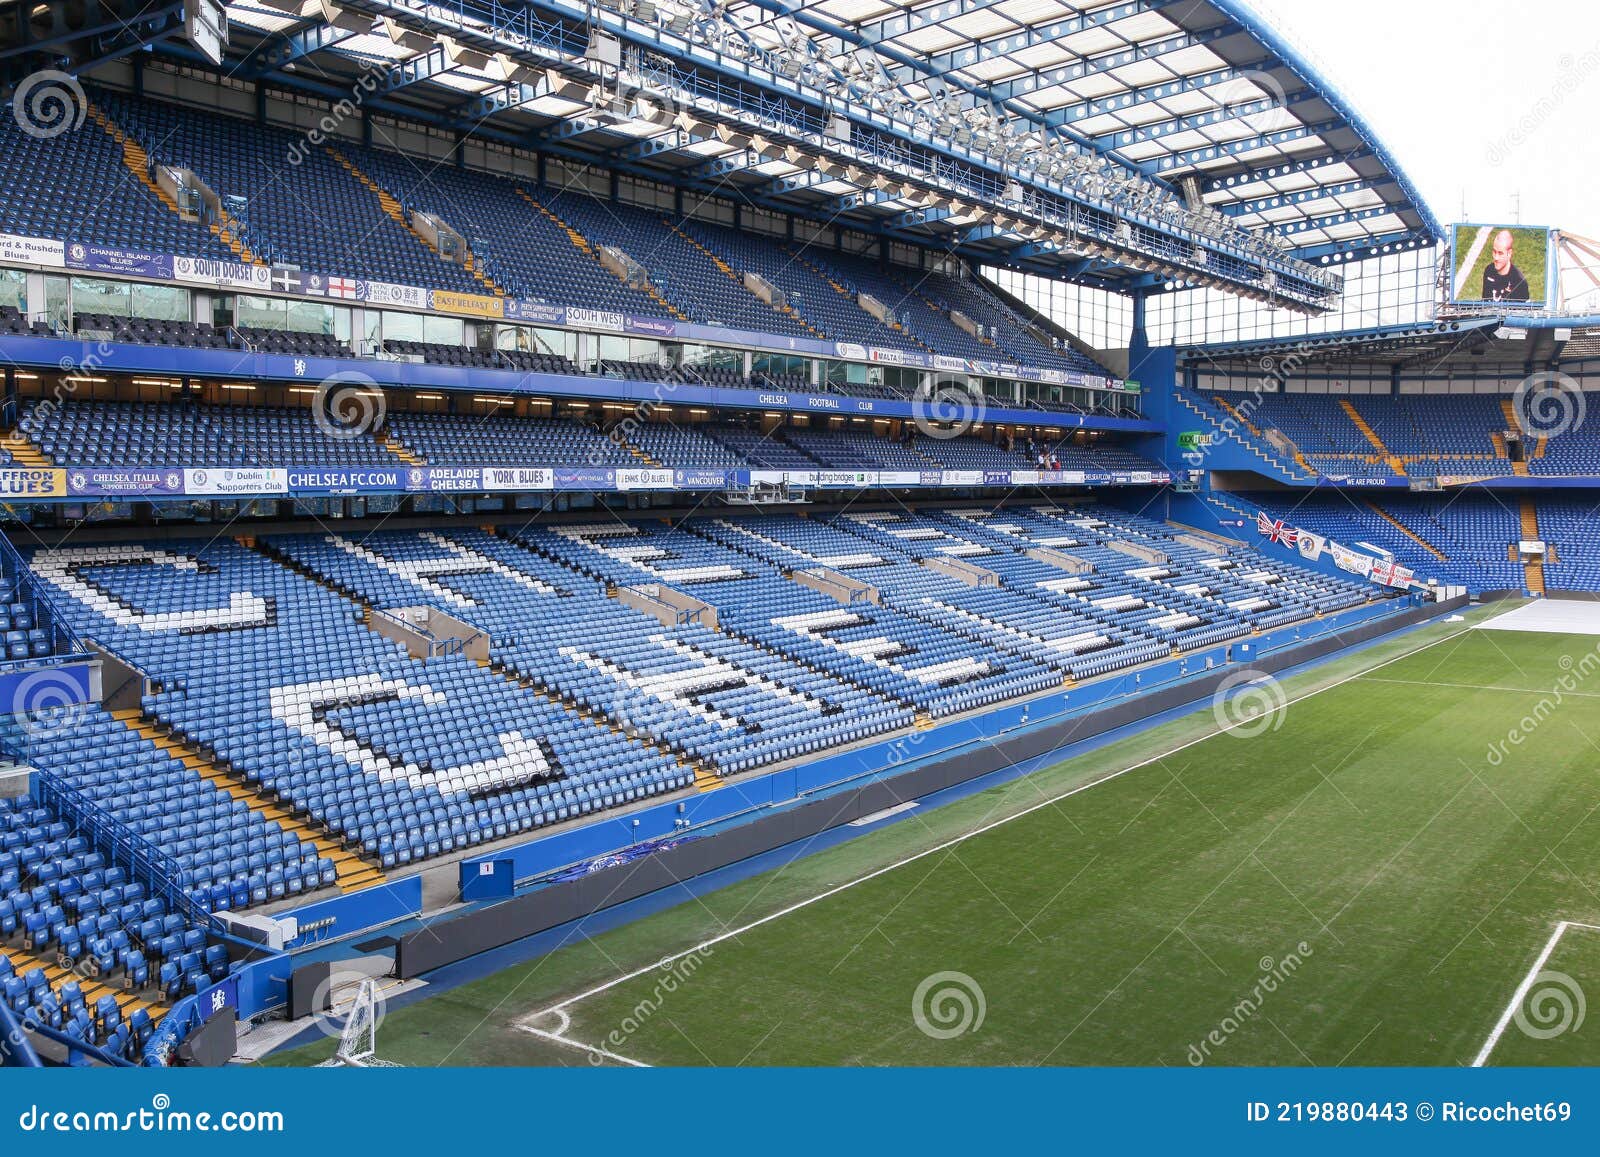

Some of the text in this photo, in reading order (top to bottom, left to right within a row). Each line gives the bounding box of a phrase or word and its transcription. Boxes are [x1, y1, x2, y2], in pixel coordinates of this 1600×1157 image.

[14, 241, 22, 249] &
[25, 242, 64, 254] Rushden
[4, 251, 30, 260] Blues
[90, 248, 151, 261] CHANNEL ISLAND
[110, 257, 133, 266] BLUES
[194, 258, 253, 282] SOUTH DORSET
[436, 296, 488, 310] EAST BELFAST
[567, 307, 623, 325] SOUTH WEST
[759, 394, 873, 410] CHELSEA FOOTBALL CLUB
[93, 473, 160, 482] CHELSEA ITALIA
[237, 472, 263, 480] Dublin
[429, 469, 480, 479] ADELAIDE
[493, 470, 544, 484] YORK BLUES
[651, 474, 666, 483] BLUES
[809, 472, 855, 483] building bridges
[431, 480, 479, 490] CHELSEA
[687, 477, 725, 485] VANCOUVER
[1347, 478, 1355, 486] WE
[1366, 478, 1386, 486] PROUD
[217, 482, 282, 493] Supporters Club
